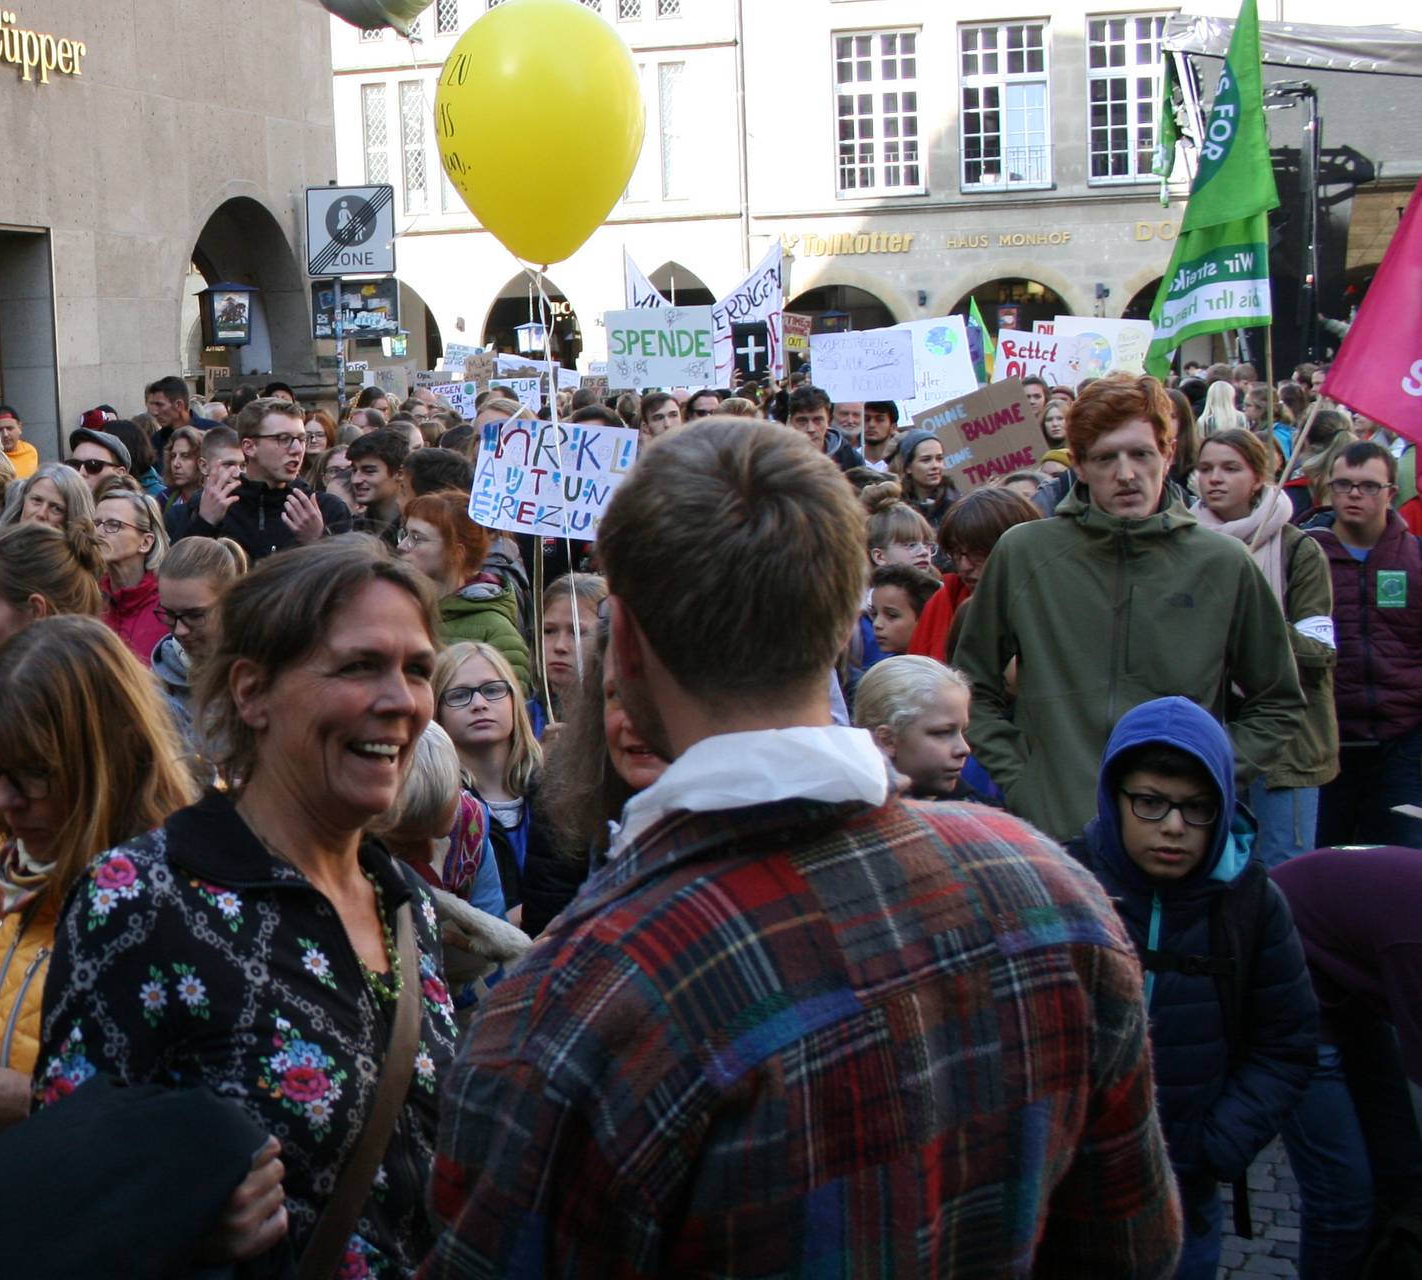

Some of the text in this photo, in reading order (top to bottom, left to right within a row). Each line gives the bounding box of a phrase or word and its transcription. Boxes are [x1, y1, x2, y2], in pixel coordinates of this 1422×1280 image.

[1201, 103, 1235, 161] FOR
[946, 234, 988, 249] HAUS
[1135, 220, 1179, 241] DO
[802, 232, 914, 256] Tollkötter
[331, 251, 375, 267] ZONE
[611, 329, 712, 358] SPENDE
[1001, 339, 1058, 362] Rettet
[511, 380, 537, 393] FÜR
[921, 403, 968, 434] OHNE
